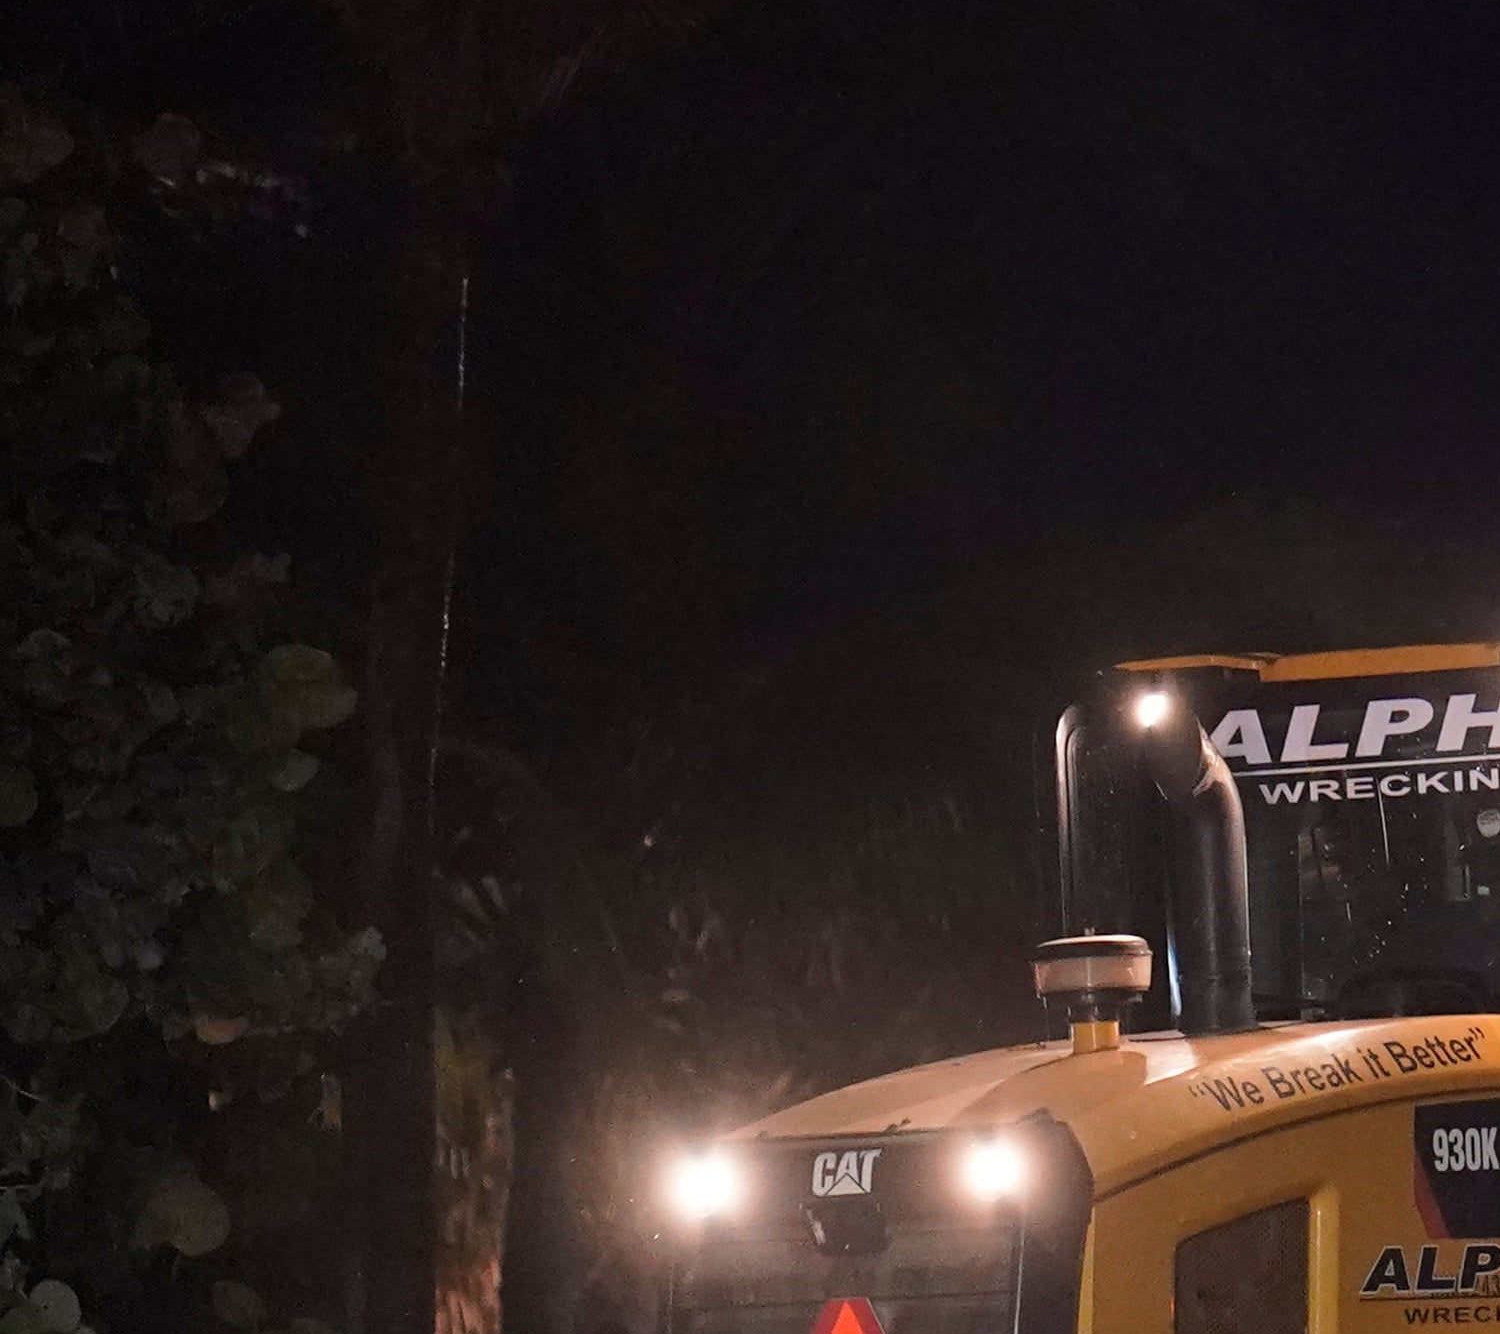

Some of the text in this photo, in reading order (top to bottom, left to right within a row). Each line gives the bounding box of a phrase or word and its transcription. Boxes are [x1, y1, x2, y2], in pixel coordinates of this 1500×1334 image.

[1261, 1054, 1362, 1100] Break
[1357, 1047, 1390, 1079] it
[812, 1149, 882, 1197] CAT
[1433, 1127, 1500, 1172] 930K
